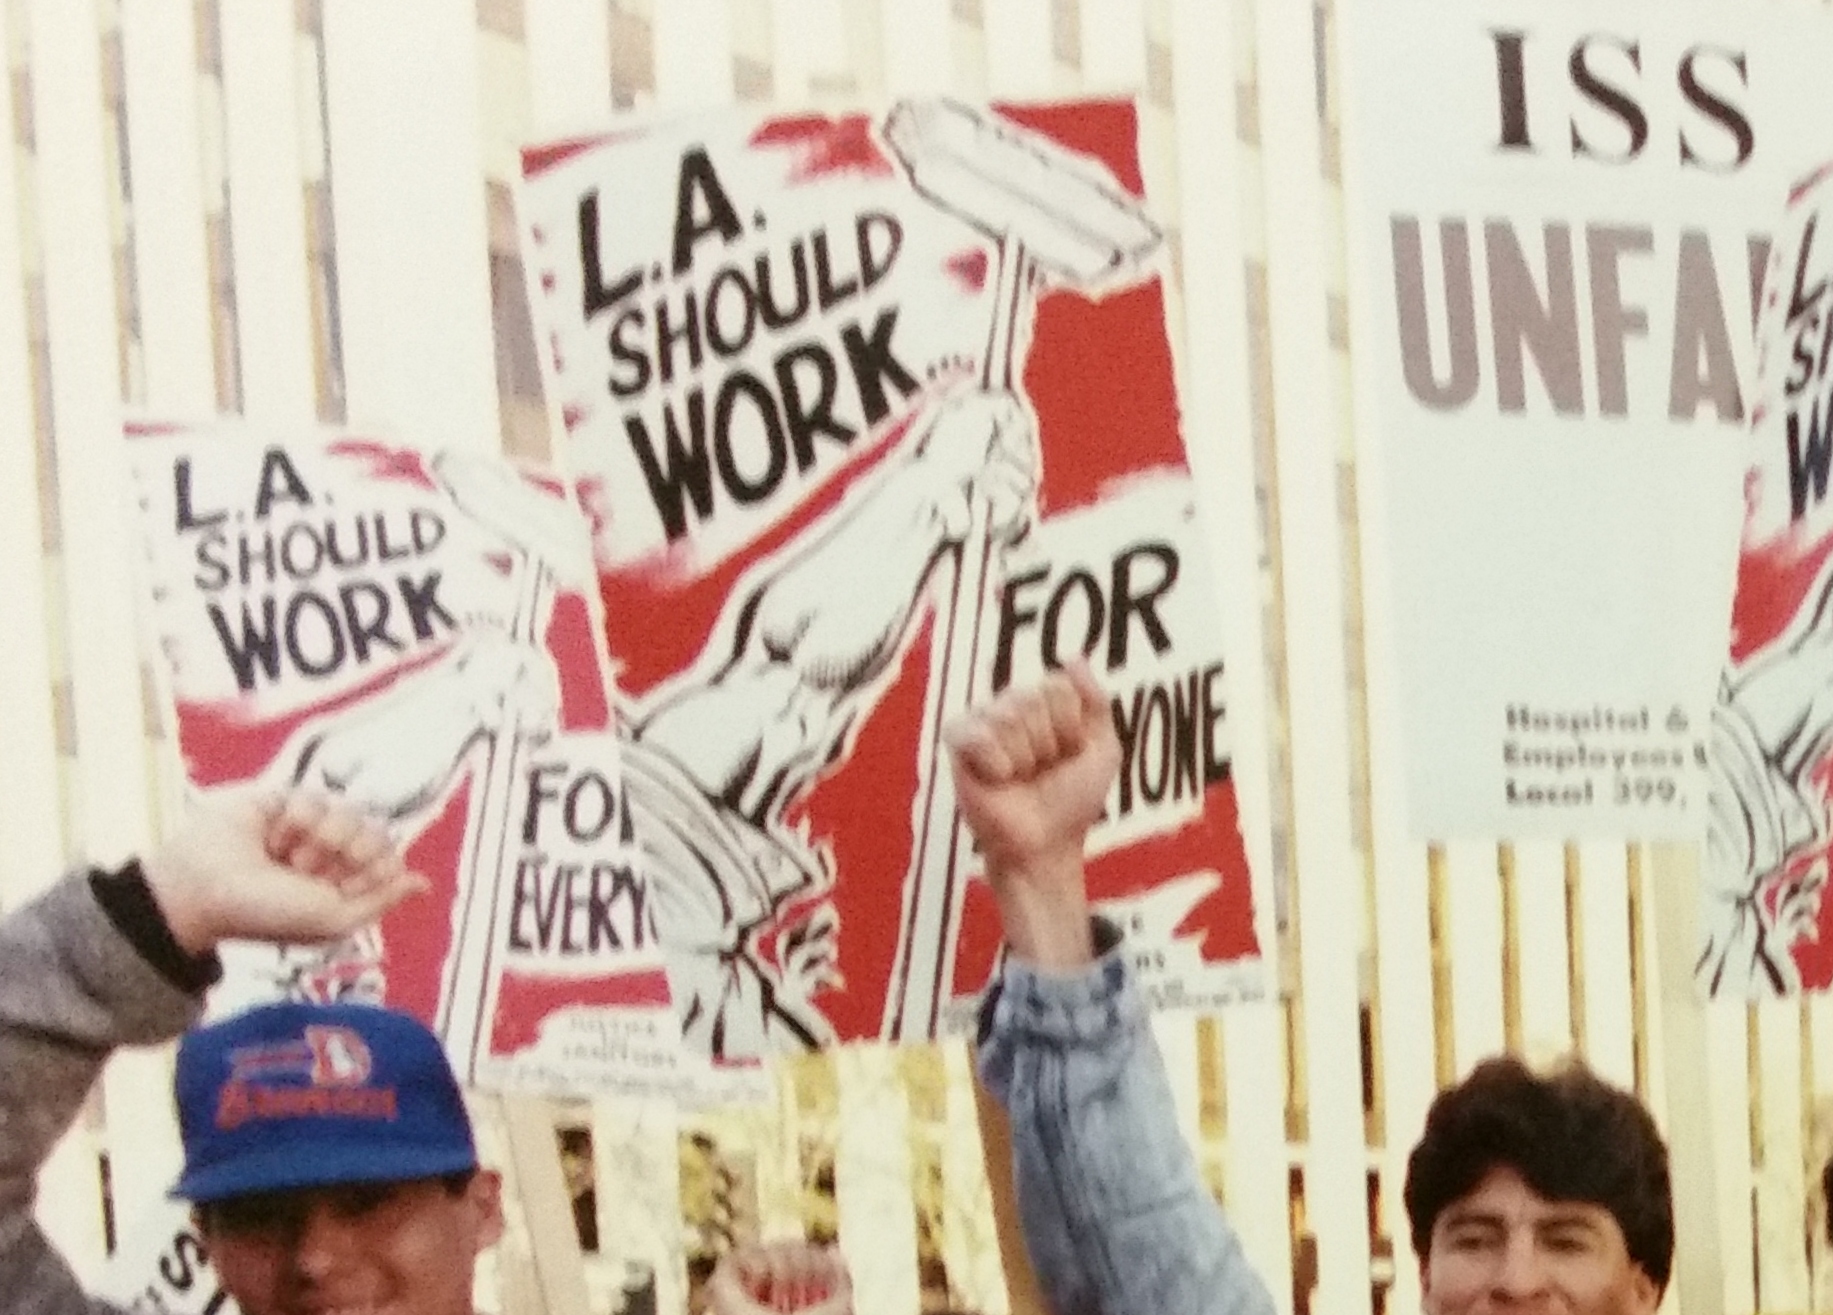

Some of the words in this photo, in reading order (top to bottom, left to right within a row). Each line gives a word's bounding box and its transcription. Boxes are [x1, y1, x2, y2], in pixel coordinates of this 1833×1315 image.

[1487, 27, 1758, 171] ISS
[578, 144, 768, 319] L.A.
[608, 211, 903, 398] SHOULD
[174, 446, 333, 533] L.A.
[195, 509, 446, 591] SHOULD
[992, 541, 1180, 692] FOR
[1104, 663, 1231, 823] YONE
[1503, 740, 1684, 774] Employees
[1505, 702, 1649, 738] Hospital
